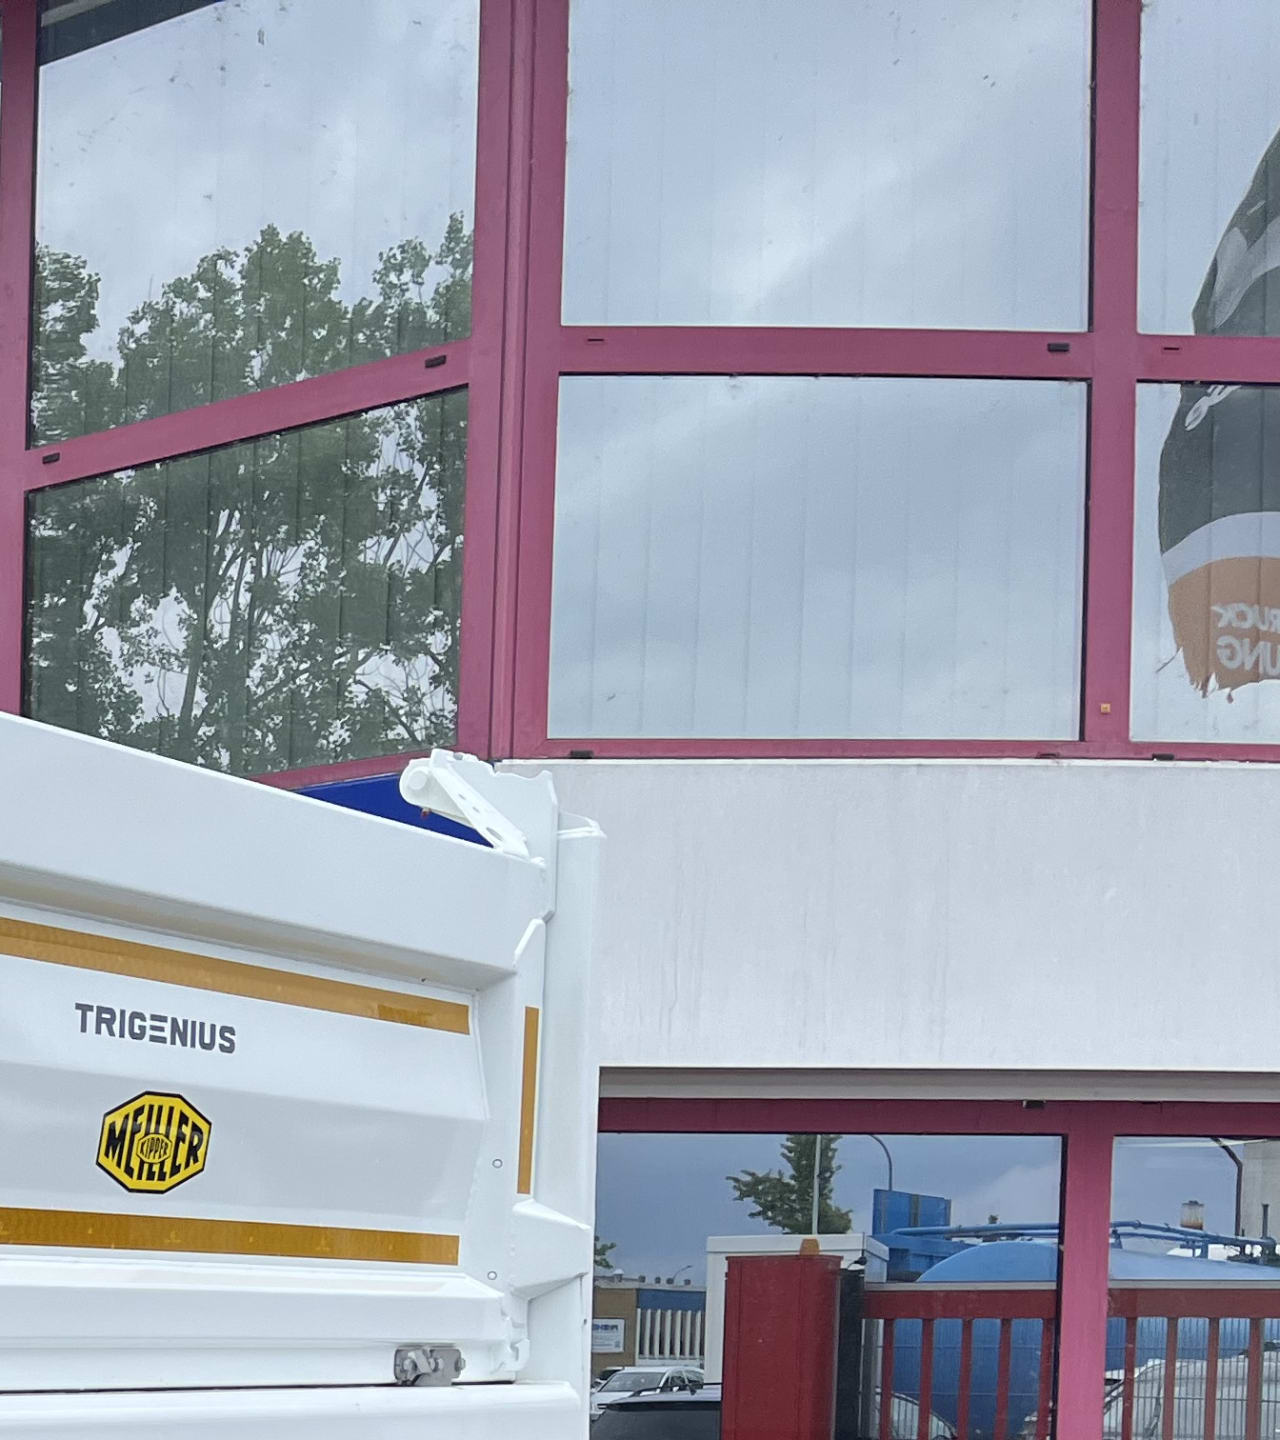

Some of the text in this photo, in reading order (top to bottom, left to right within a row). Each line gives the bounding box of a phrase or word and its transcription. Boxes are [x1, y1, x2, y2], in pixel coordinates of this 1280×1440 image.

[75, 1002, 237, 1055] TRIGENIUS
[103, 1103, 205, 1182] MEILLER
[139, 1136, 169, 1160] KIPPER
